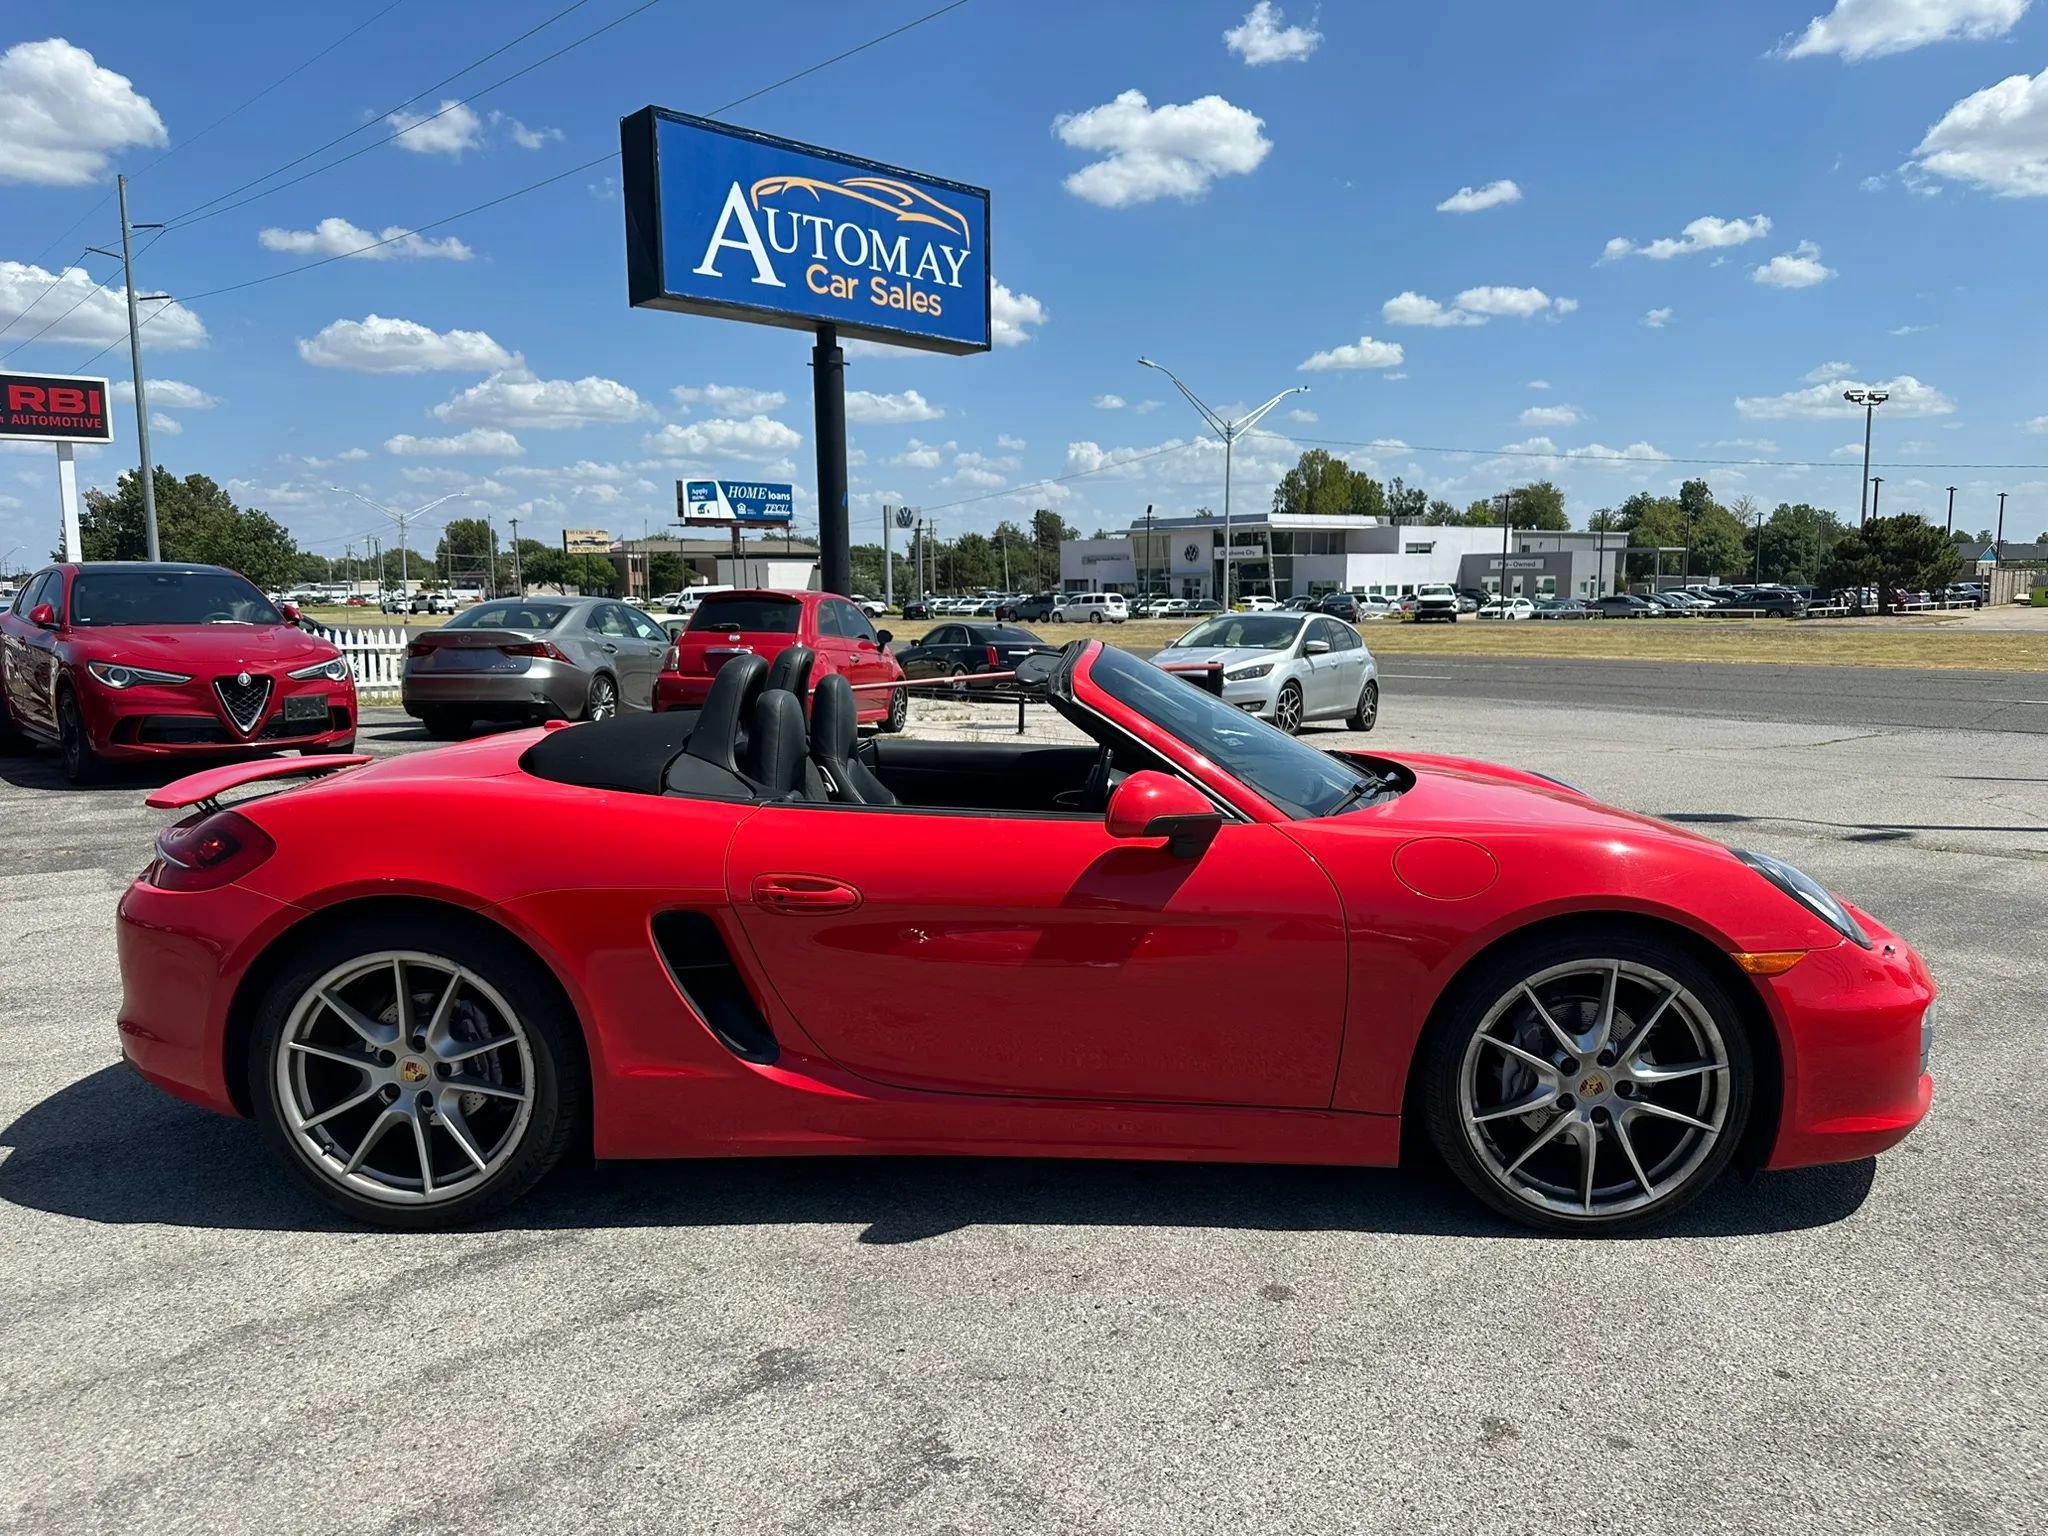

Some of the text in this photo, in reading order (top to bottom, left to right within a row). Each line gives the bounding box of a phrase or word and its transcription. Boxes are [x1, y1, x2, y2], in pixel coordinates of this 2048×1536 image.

[692, 181, 971, 288] AUTOMAY
[805, 263, 943, 317] Car Sales
[8, 385, 101, 415] RBI
[11, 414, 102, 429] AUTOMOTIVE
[691, 487, 708, 496] Apply
[728, 485, 790, 501] HOME loans
